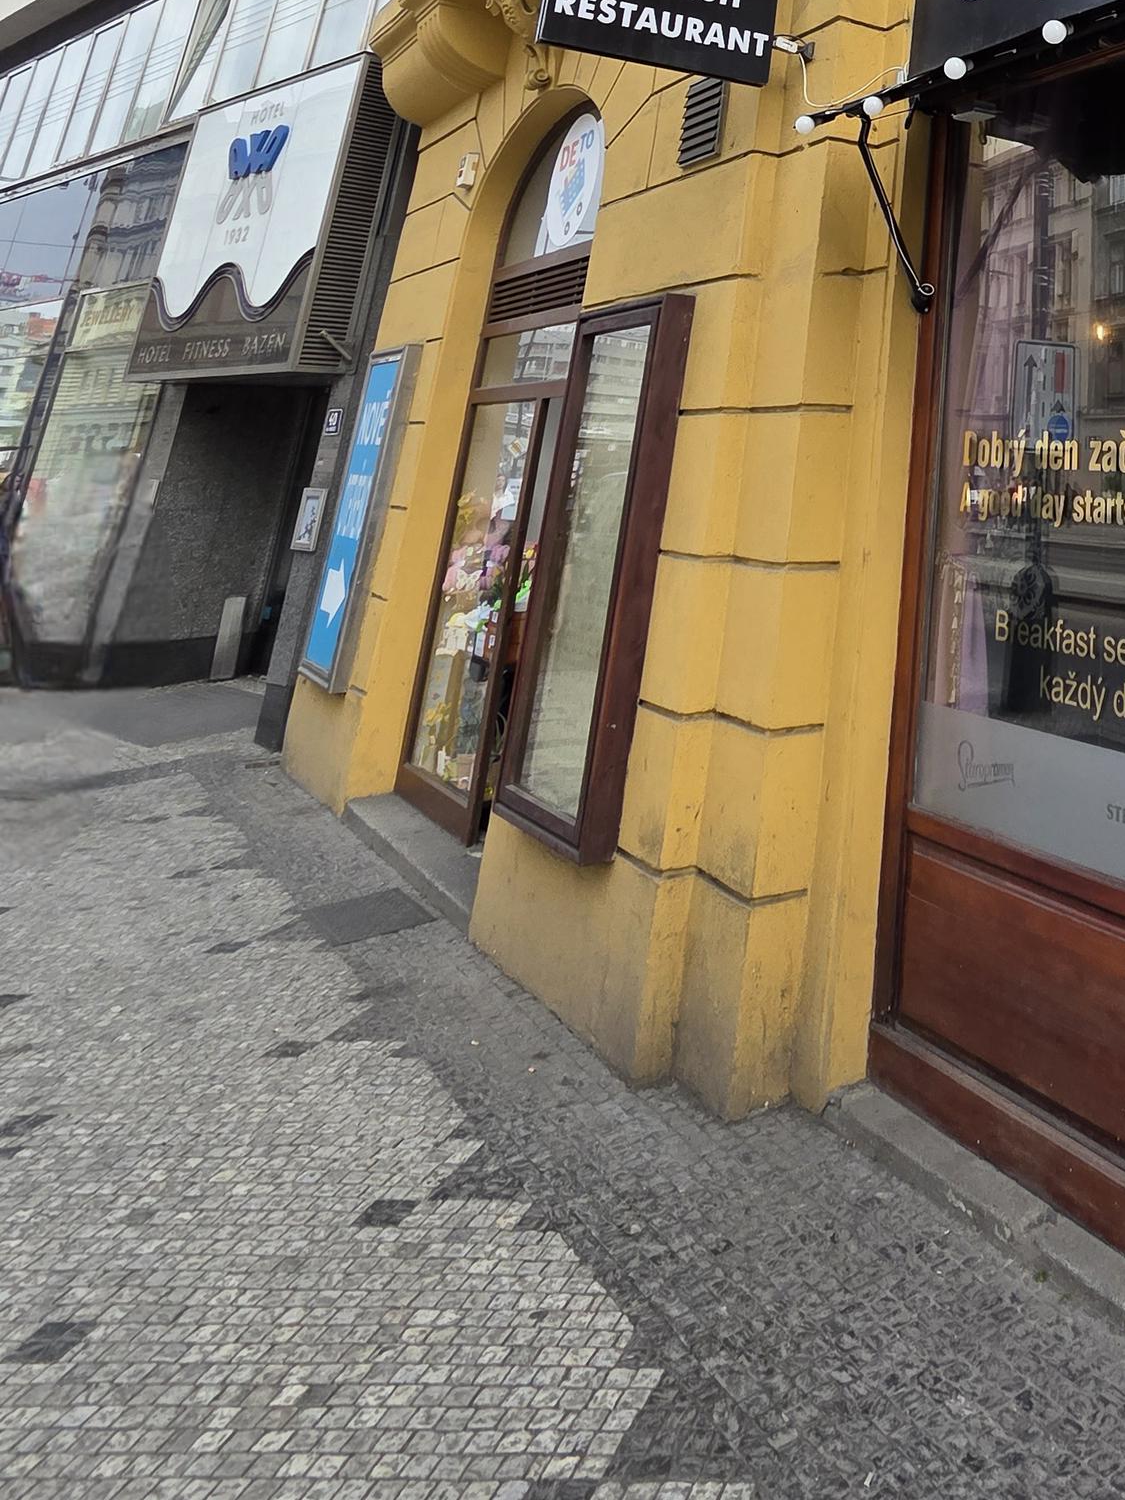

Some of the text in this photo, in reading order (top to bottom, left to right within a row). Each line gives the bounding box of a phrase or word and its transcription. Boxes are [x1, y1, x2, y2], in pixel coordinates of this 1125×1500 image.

[251, 102, 285, 125] HOTEL
[224, 226, 250, 245] 1932
[138, 343, 171, 363] HOTEL
[182, 337, 231, 361] FITNESS
[962, 429, 1026, 477] Dobrý
[1035, 431, 1079, 470] den
[960, 481, 971, 513] A
[978, 482, 1023, 521] good
[1031, 484, 1065, 528] day
[995, 610, 1096, 660] Breakfast
[1040, 665, 1106, 721] každý
